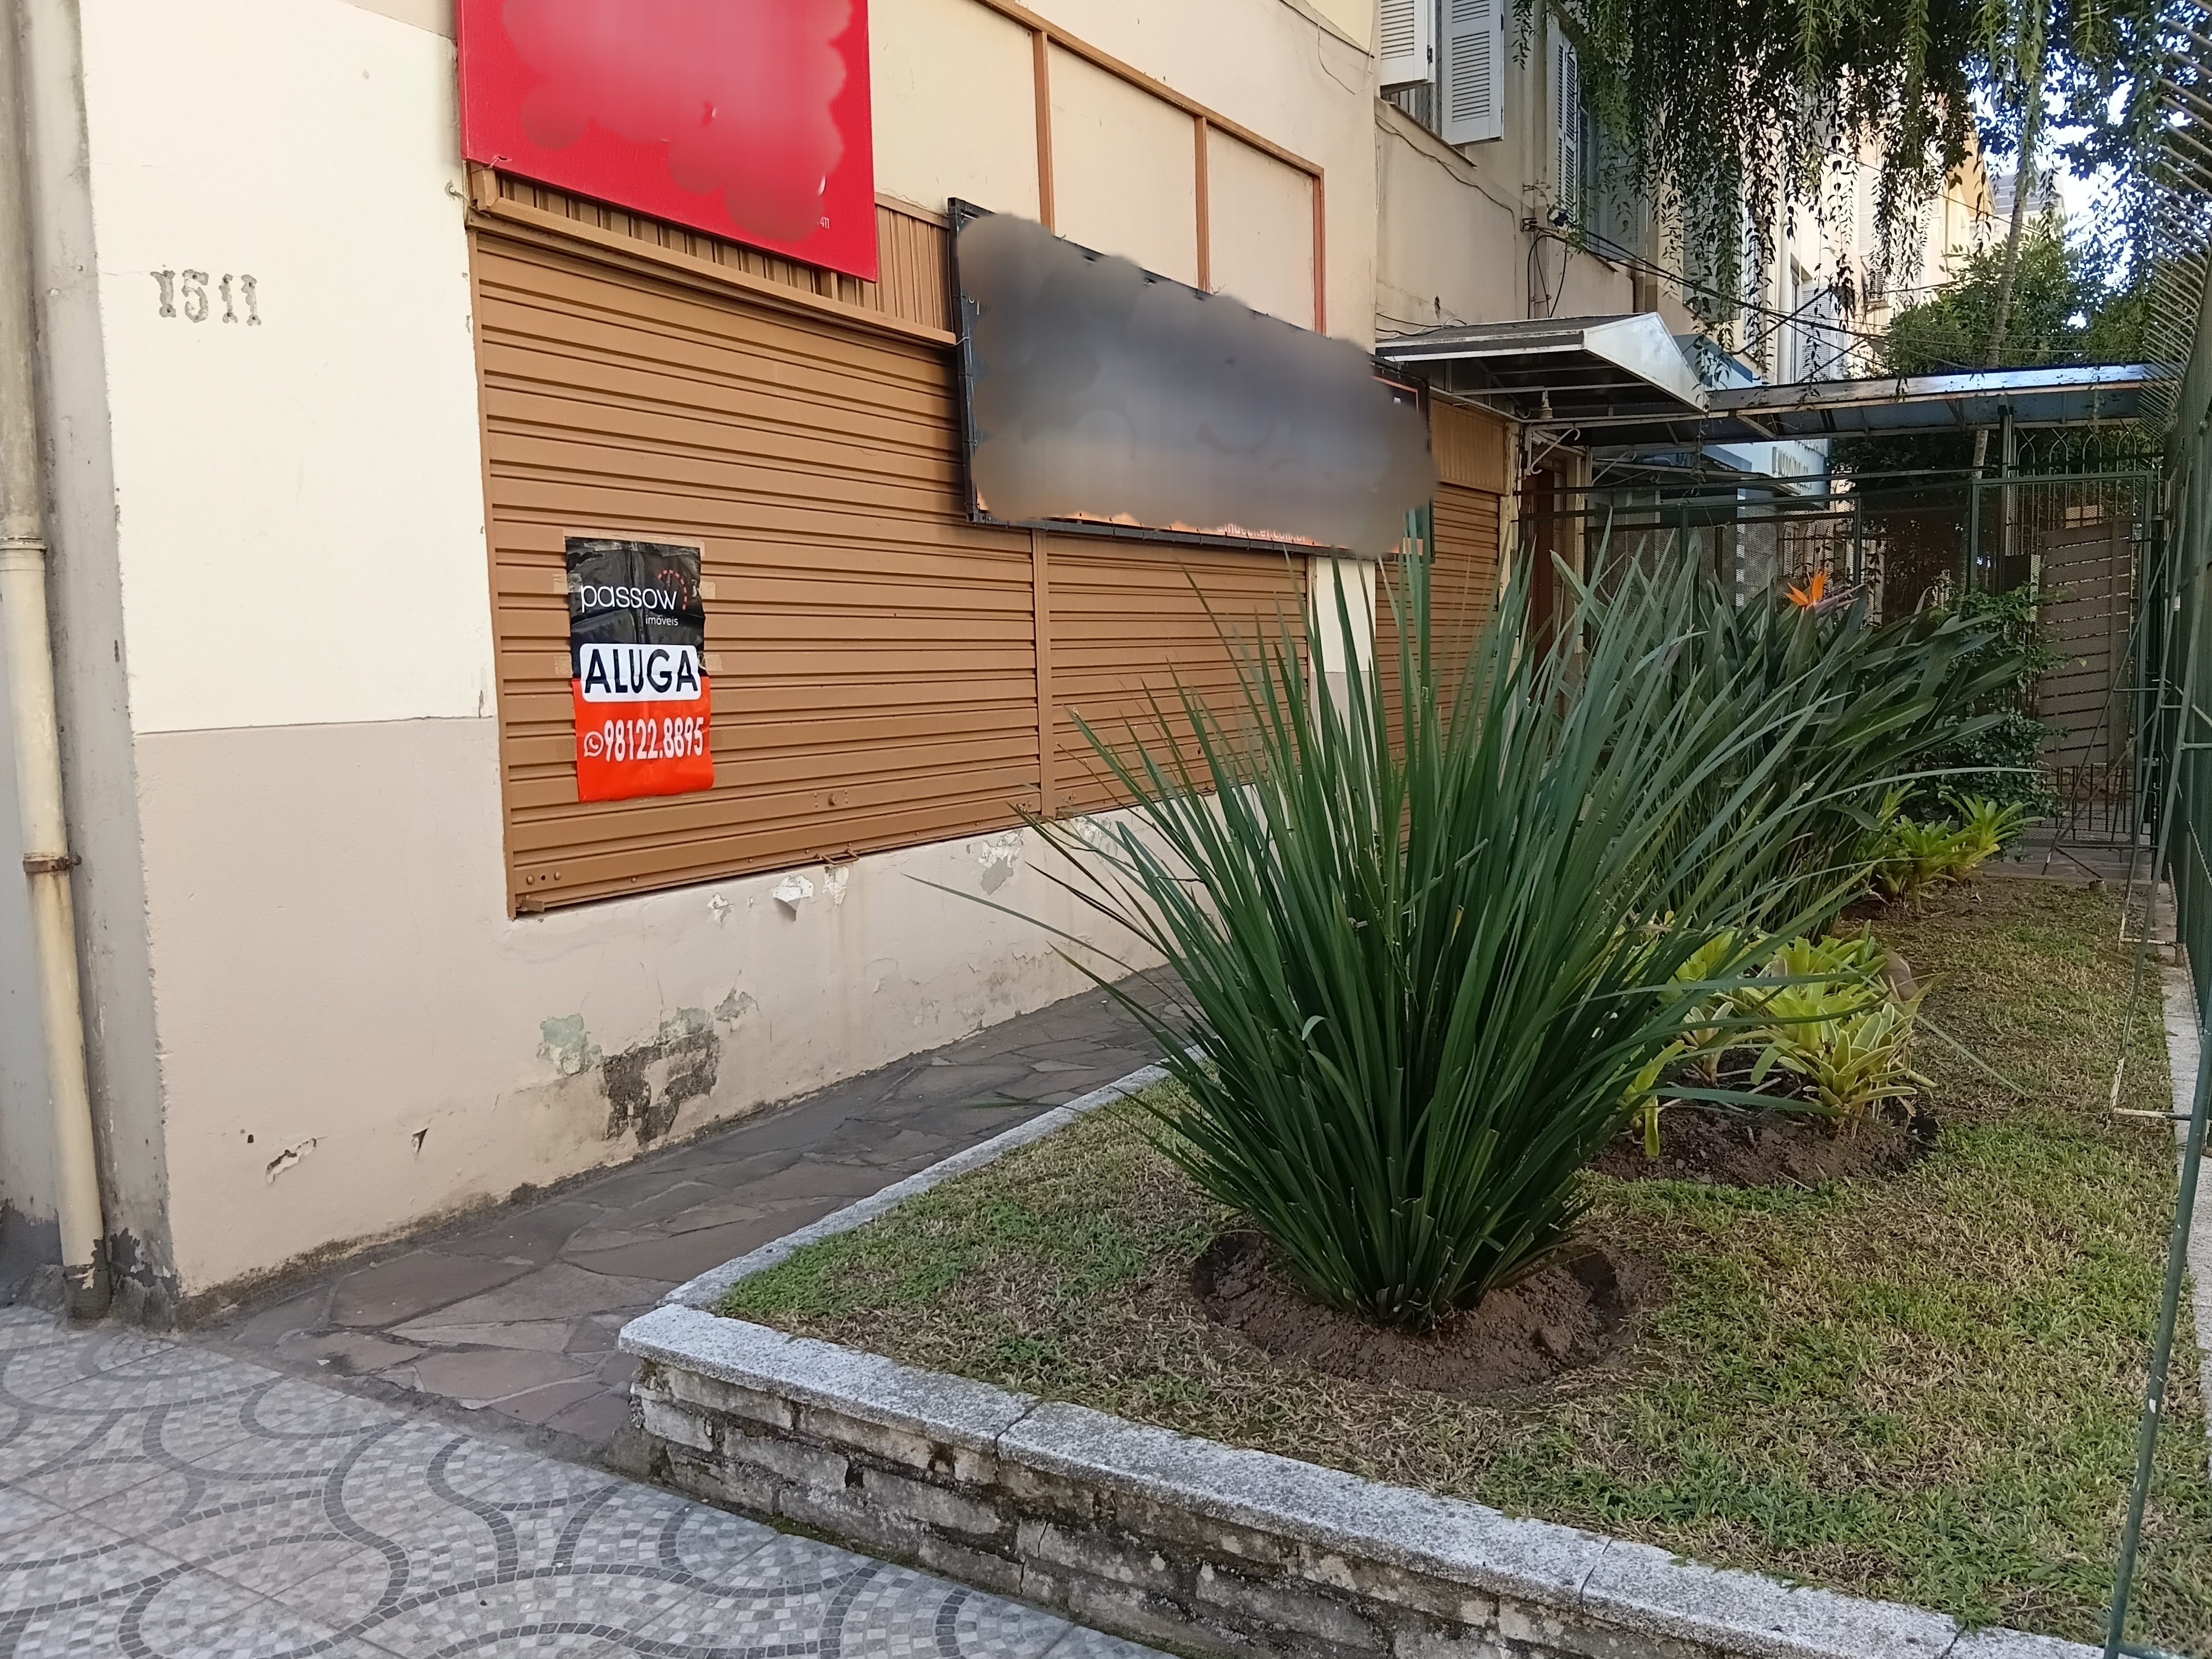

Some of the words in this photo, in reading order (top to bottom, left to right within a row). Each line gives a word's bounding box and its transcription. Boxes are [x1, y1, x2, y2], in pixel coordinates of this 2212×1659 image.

[150, 269, 262, 327] 1511
[1215, 523, 1306, 542] eindecker.com.br
[581, 585, 677, 613] passow
[645, 614, 679, 626] imóveis
[584, 648, 698, 694] ALUGA
[604, 716, 704, 762] 98122.8895
